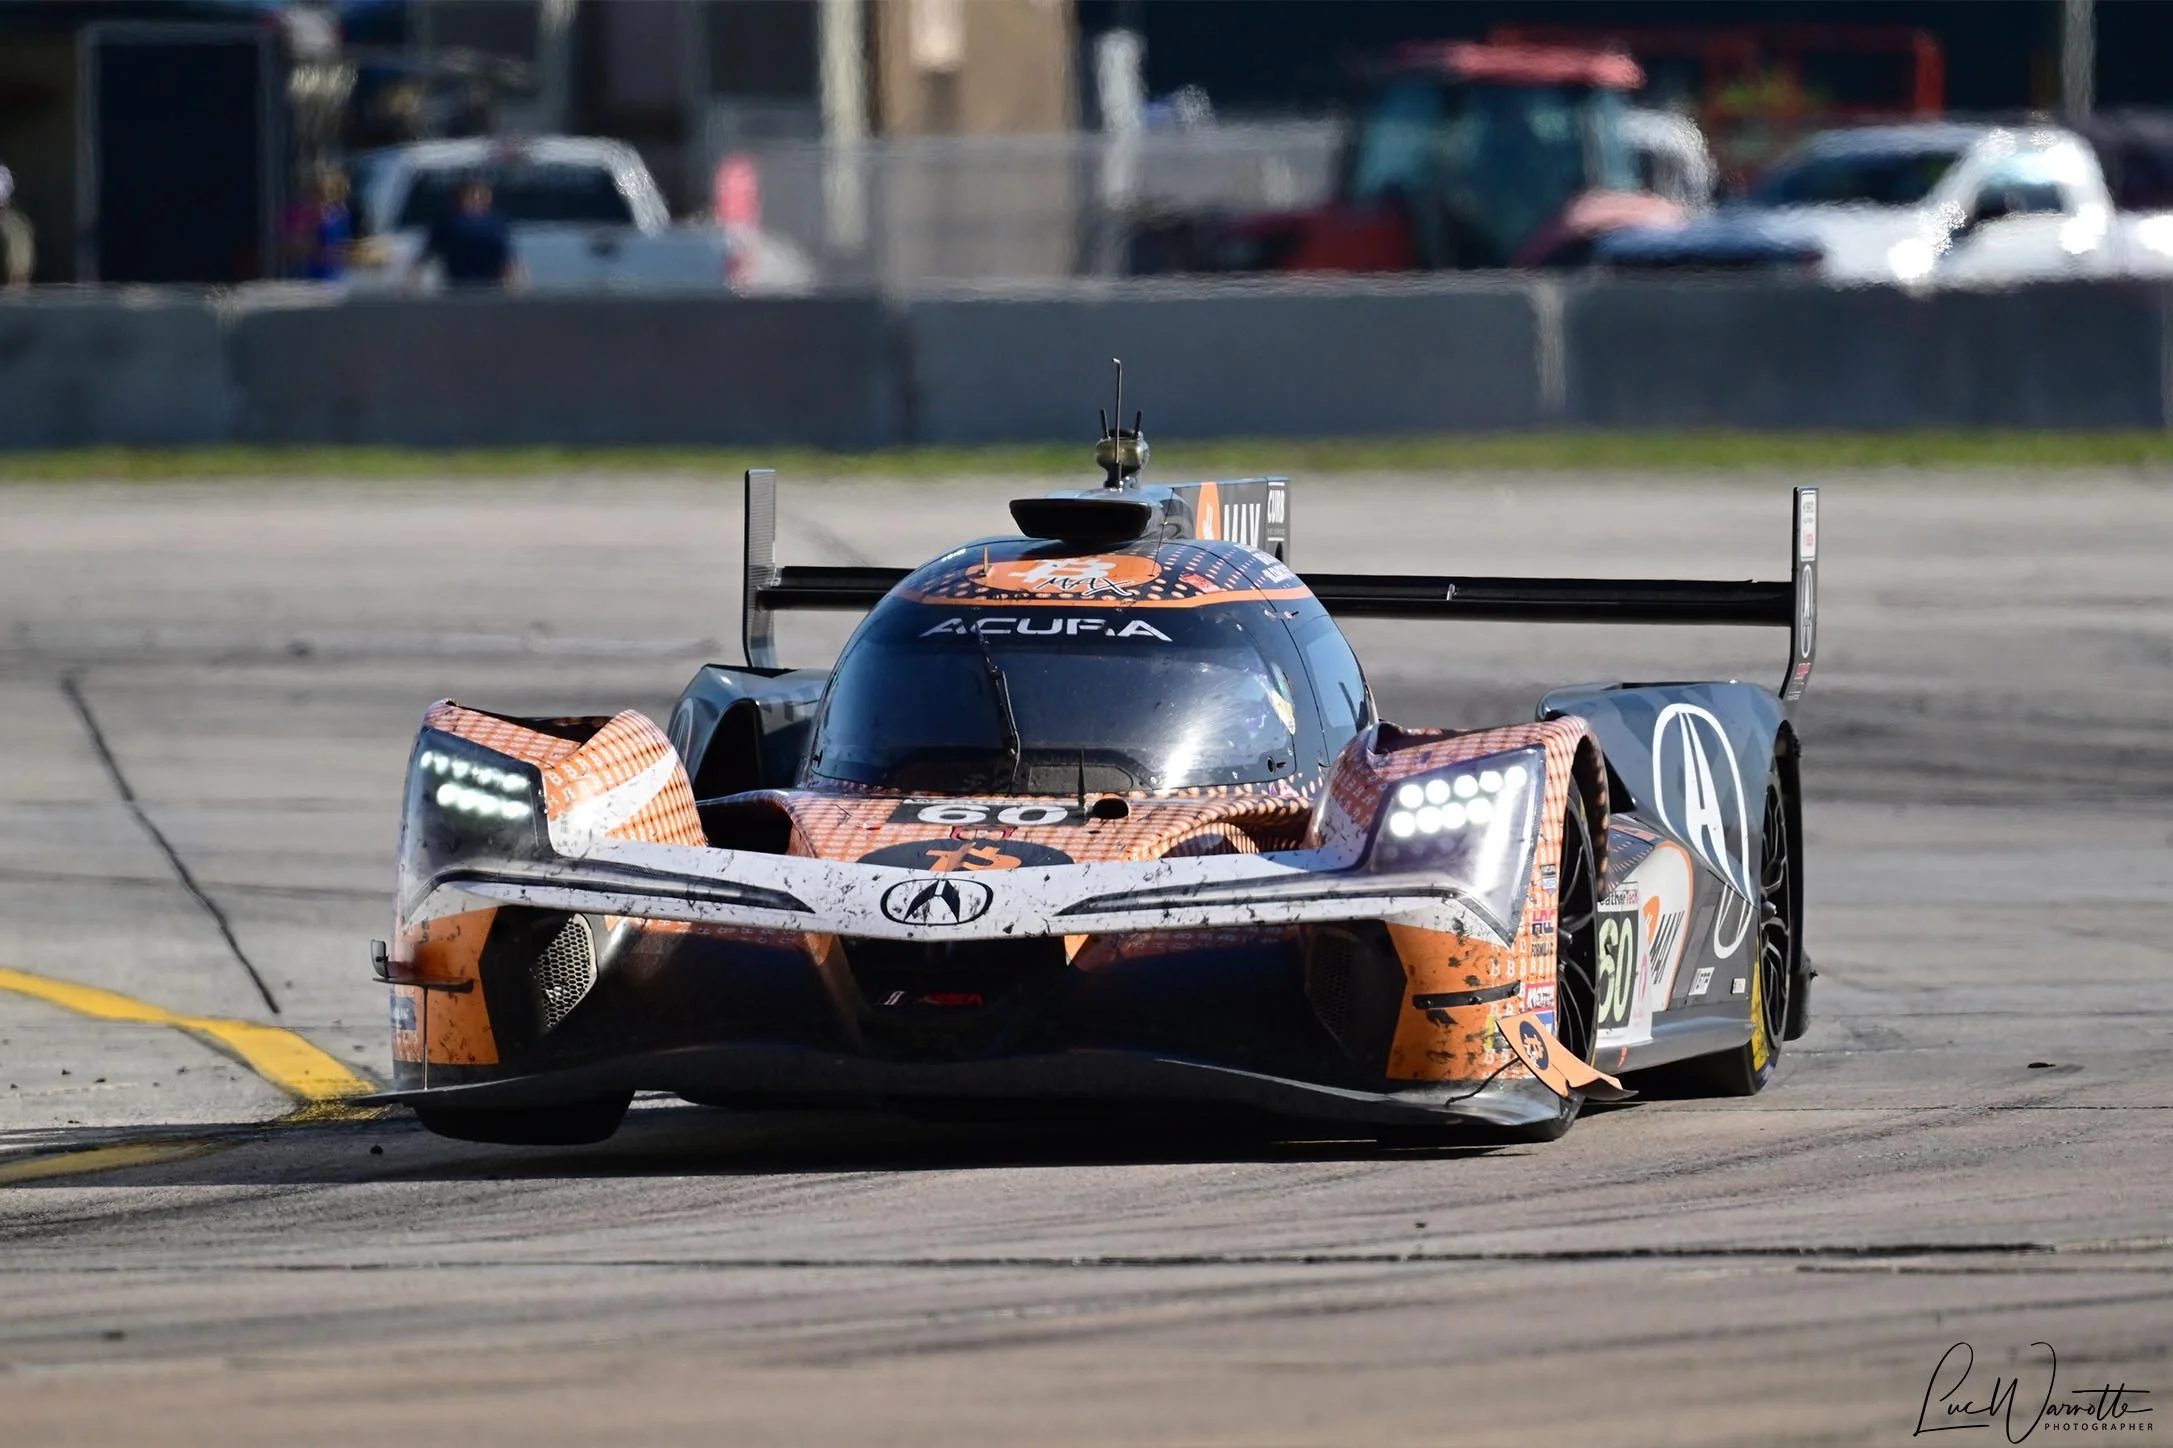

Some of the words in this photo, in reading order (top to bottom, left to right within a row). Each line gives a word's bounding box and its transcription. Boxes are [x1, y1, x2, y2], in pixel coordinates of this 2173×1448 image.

[920, 617, 1173, 642] ACURA
[917, 803, 1069, 826] 60
[1597, 916, 1634, 1024] 60
